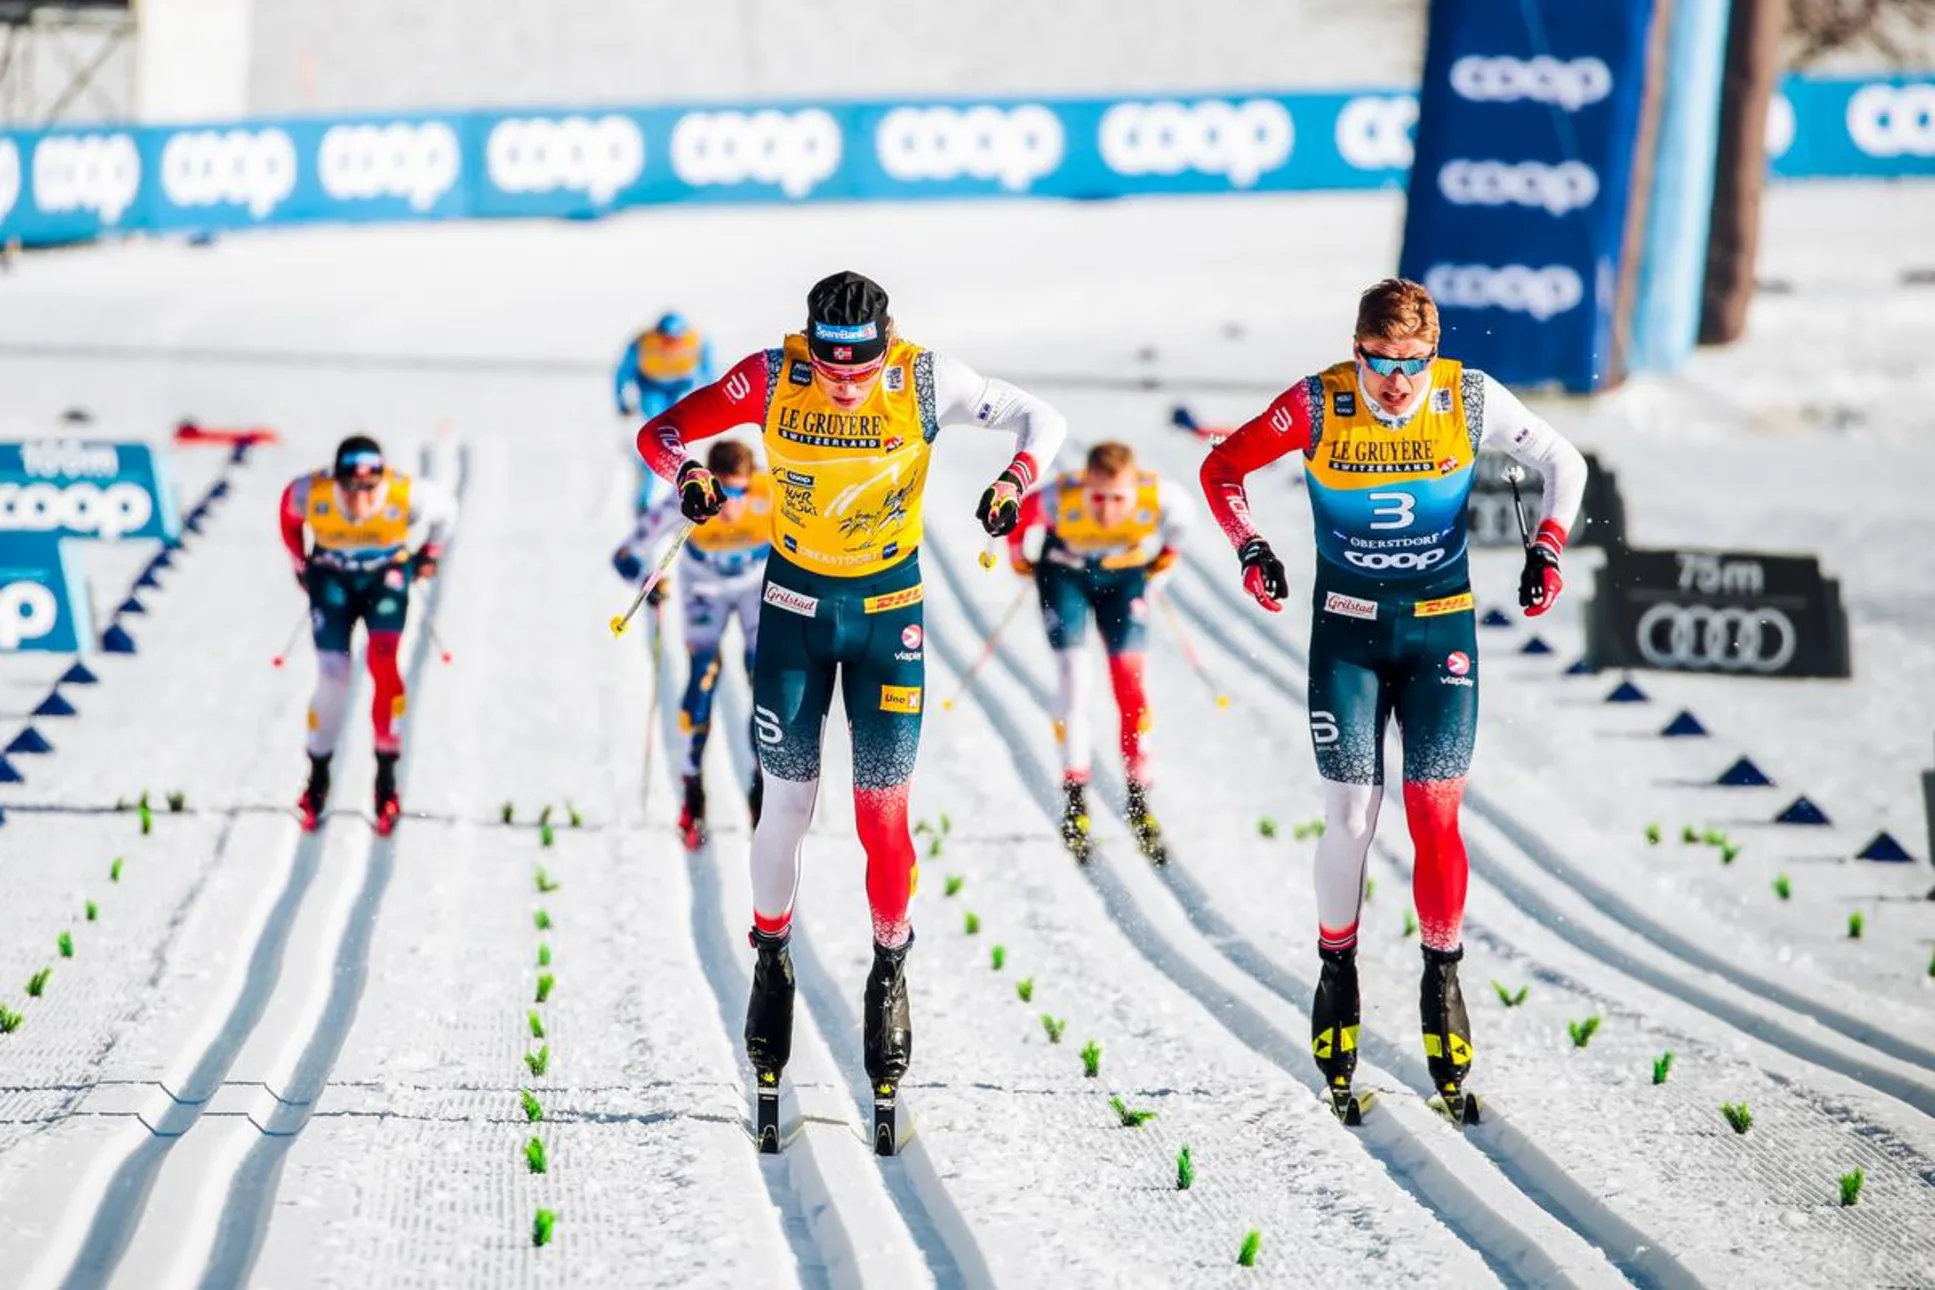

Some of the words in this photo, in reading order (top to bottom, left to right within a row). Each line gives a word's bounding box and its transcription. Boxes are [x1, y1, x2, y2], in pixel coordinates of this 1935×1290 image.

[1450, 56, 1612, 111] coop
[1100, 99, 1294, 188] coop
[1335, 95, 1419, 169] co
[1846, 84, 1935, 157] co
[318, 121, 459, 210] coop
[487, 114, 644, 204] coop
[671, 108, 842, 199] coop
[877, 104, 1064, 192] coop
[161, 128, 297, 218] coop
[1438, 159, 1599, 215] coop
[1425, 264, 1583, 321] coop
[779, 406, 799, 430] LE
[782, 430, 876, 447] SWITZERLAND
[1331, 440, 1350, 460] LE
[1333, 462, 1430, 473] SWITZERLAND
[1368, 492, 1416, 530] 3
[1344, 548, 1445, 570] coop
[1350, 534, 1440, 549] OBERSTDORF
[1675, 553, 1765, 593] 75m
[767, 585, 814, 611] Grilstad
[1328, 595, 1375, 614] Grilstad
[885, 693, 906, 703] Uno
